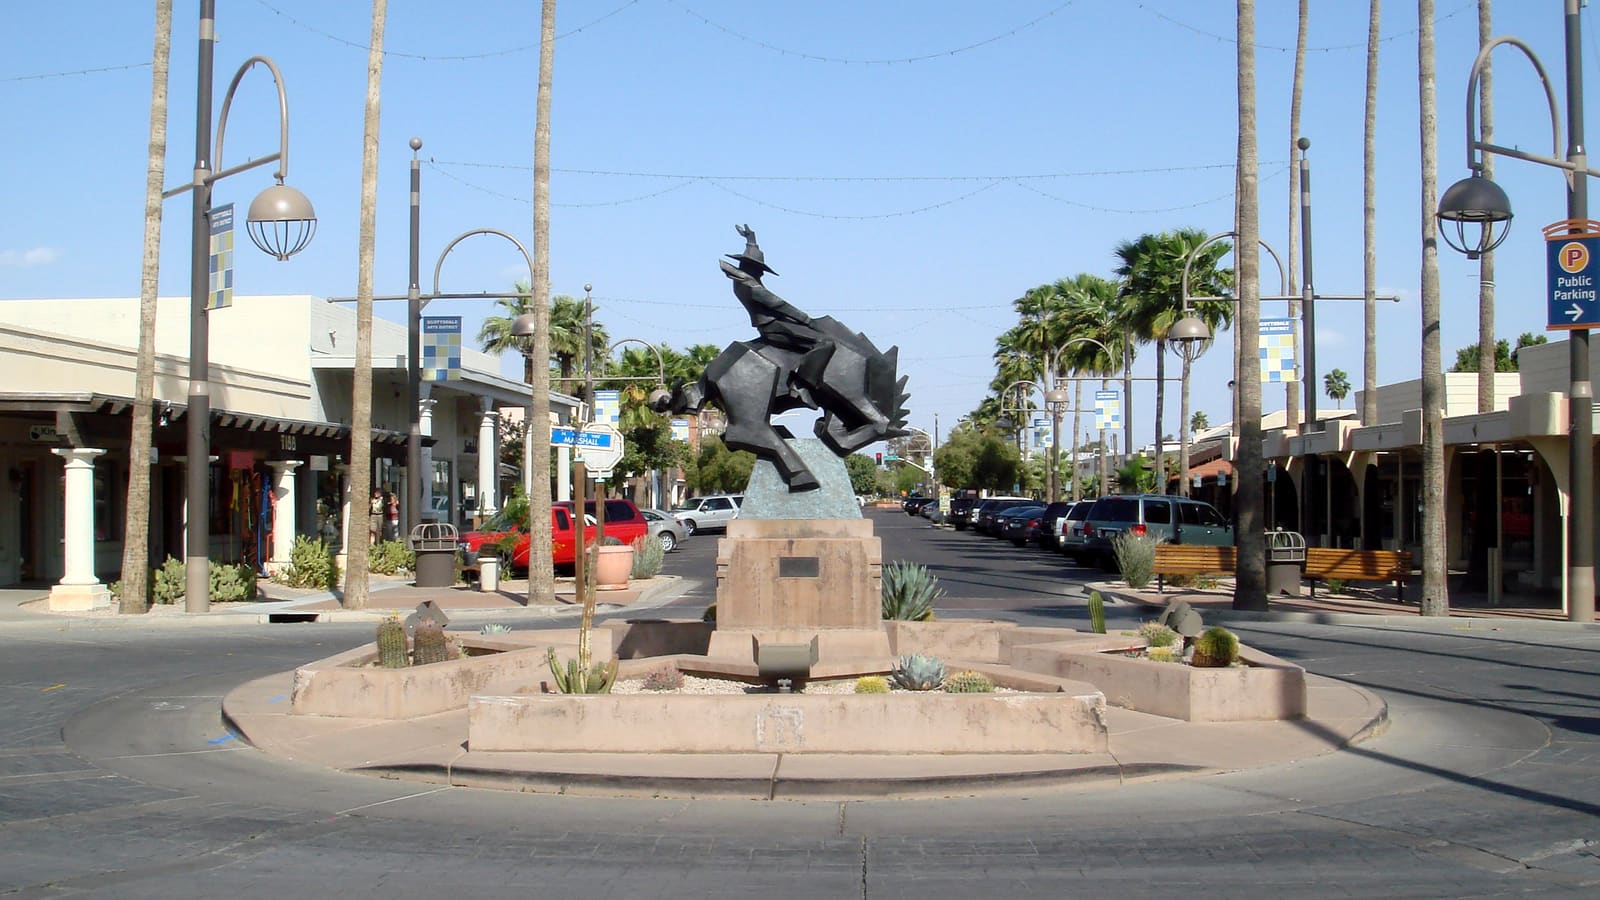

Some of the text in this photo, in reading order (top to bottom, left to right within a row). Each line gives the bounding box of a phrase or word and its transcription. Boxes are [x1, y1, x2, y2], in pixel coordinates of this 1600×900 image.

[1567, 249, 1583, 267] P
[1558, 276, 1592, 287] Public
[1554, 289, 1596, 301] Parking
